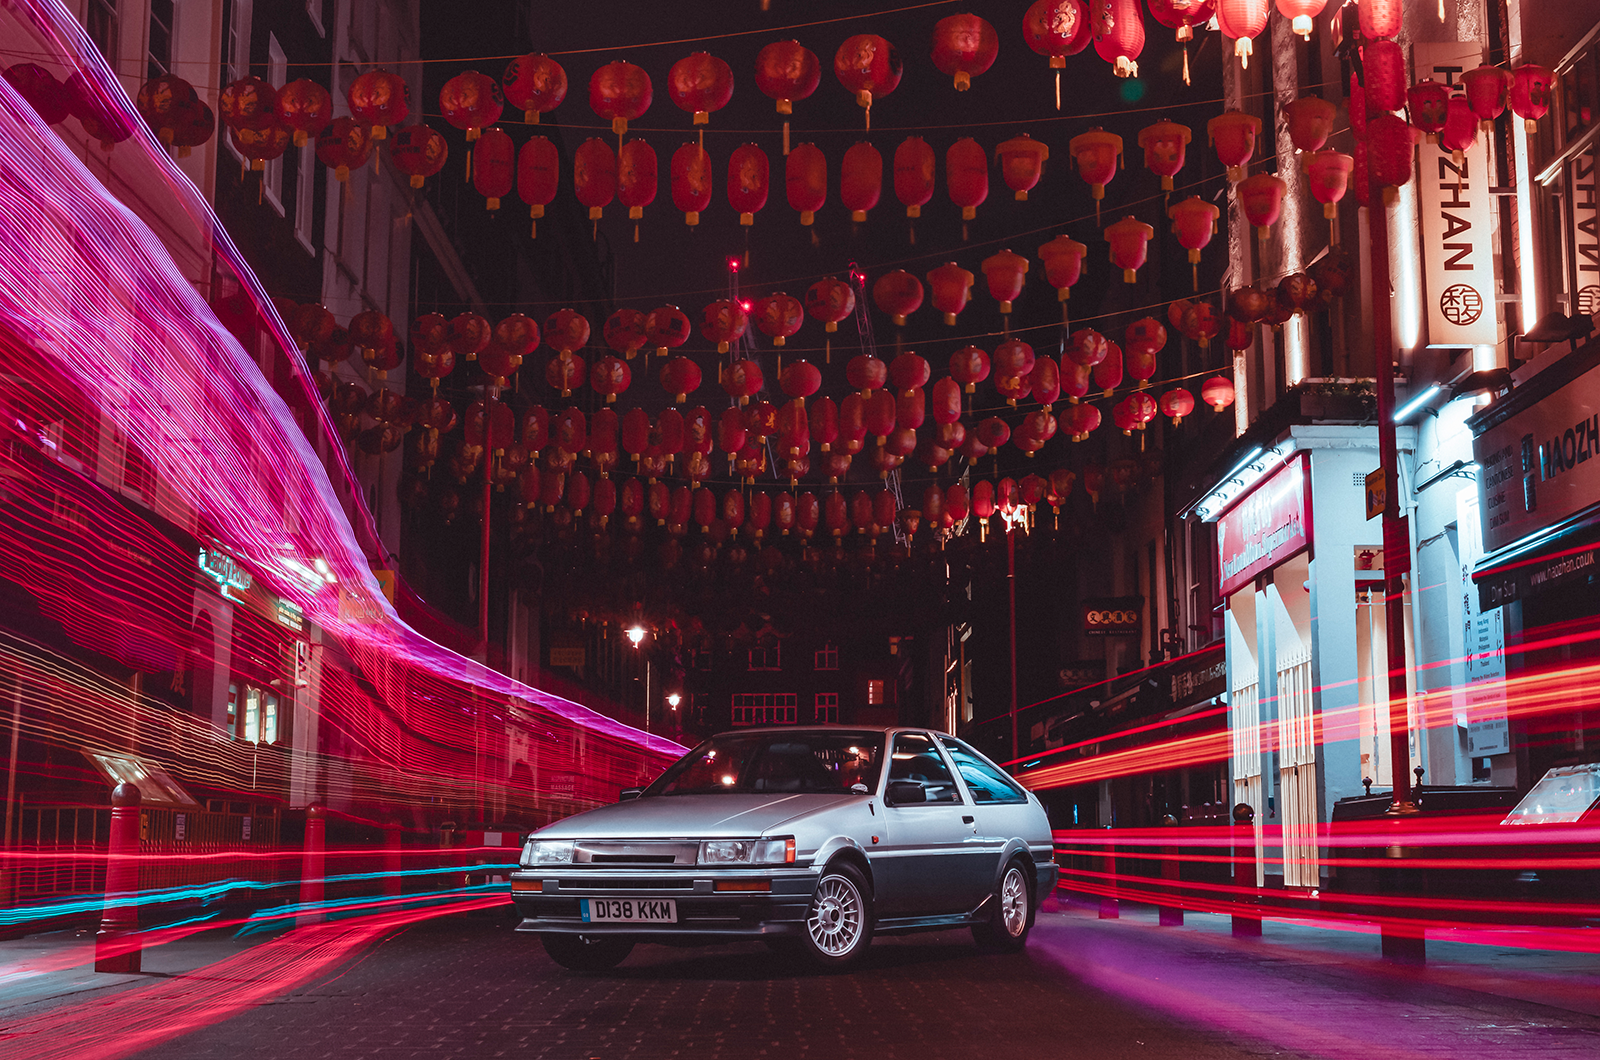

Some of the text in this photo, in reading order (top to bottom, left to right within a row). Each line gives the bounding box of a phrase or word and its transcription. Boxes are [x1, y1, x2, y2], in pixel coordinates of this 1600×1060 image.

[1433, 66, 1475, 271] HZHAN
[1485, 465, 1514, 490] CANTONESE
[1487, 490, 1505, 509] CUISINE
[1245, 541, 1261, 566] Moon
[1261, 511, 1300, 560] Supermarket
[1530, 549, 1595, 586] www.haozhan.co.uk
[1491, 580, 1516, 603] Dim Sum
[595, 901, 671, 919] D138 KKM
